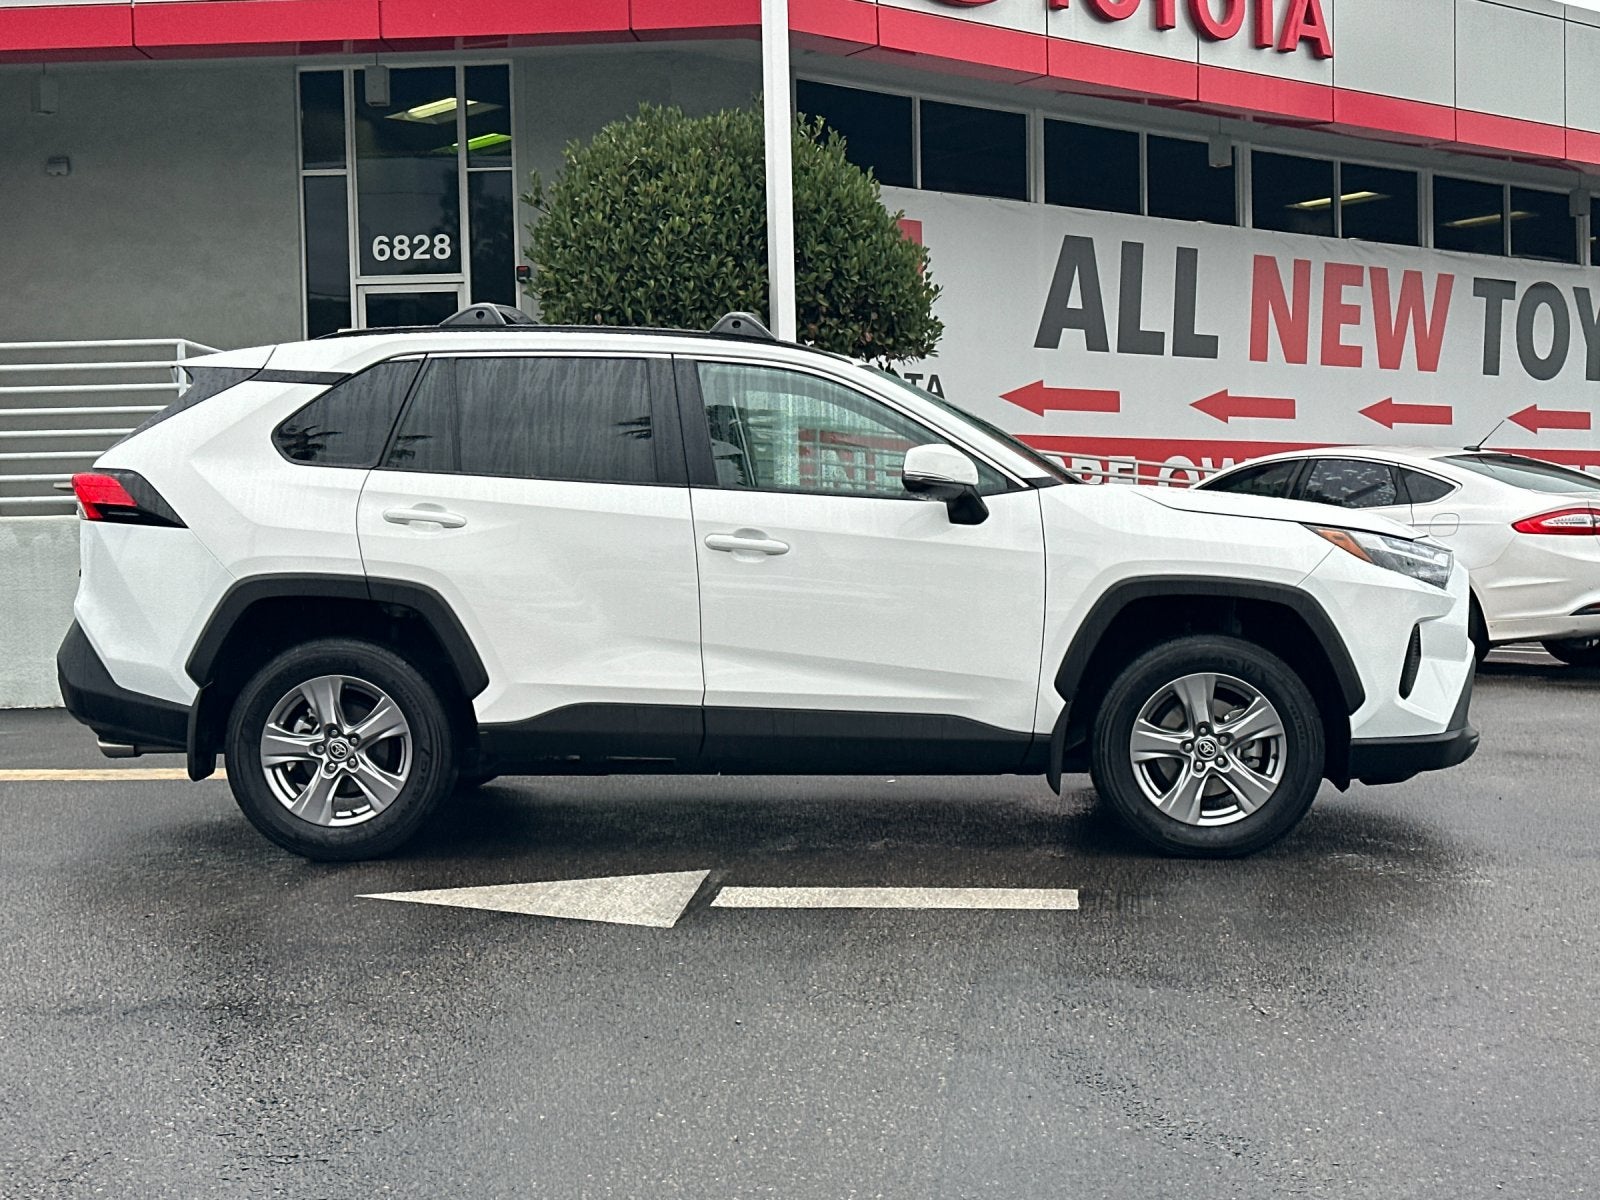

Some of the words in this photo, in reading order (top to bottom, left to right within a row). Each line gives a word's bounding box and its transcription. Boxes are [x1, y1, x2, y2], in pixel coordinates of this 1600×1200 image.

[372, 233, 451, 261] 6828
[1034, 235, 1218, 358] ALL
[1250, 254, 1454, 372] NEW
